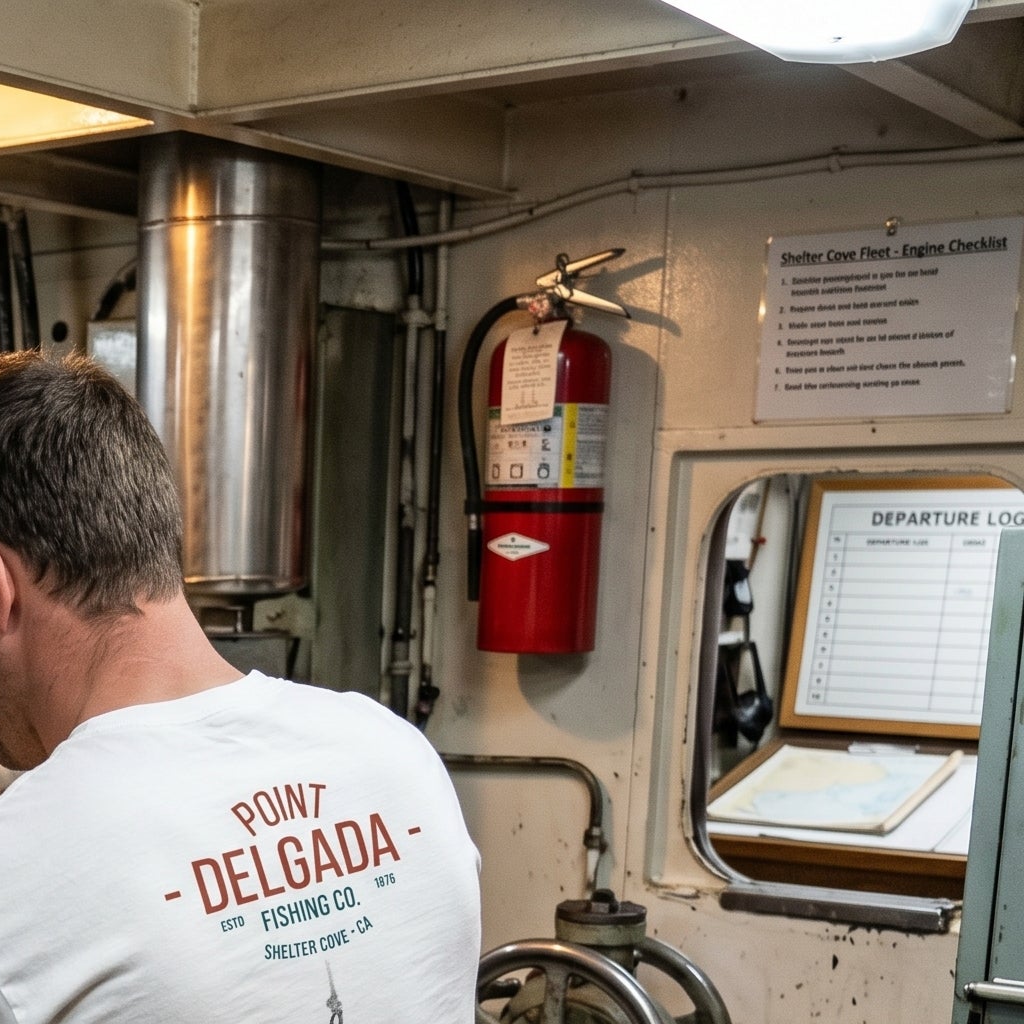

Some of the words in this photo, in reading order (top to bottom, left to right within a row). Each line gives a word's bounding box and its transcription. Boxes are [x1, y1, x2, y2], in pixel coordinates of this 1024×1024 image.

[780, 250, 823, 266] Shelter
[827, 248, 856, 262] Cove
[860, 245, 891, 260] Fleet
[902, 242, 945, 259] Engine
[949, 235, 1008, 252] Checklist
[872, 511, 980, 526] DEPARTURE
[987, 511, 1024, 526] LOG
[230, 783, 326, 837] POINT
[191, 812, 401, 915] DELGADA
[220, 915, 245, 933] ESTD
[260, 894, 330, 932] FISHING
[332, 886, 361, 911] CO.
[374, 872, 396, 889] 1876
[264, 939, 317, 961] SHELTER
[319, 929, 350, 952] COVE
[356, 916, 374, 935] CA
